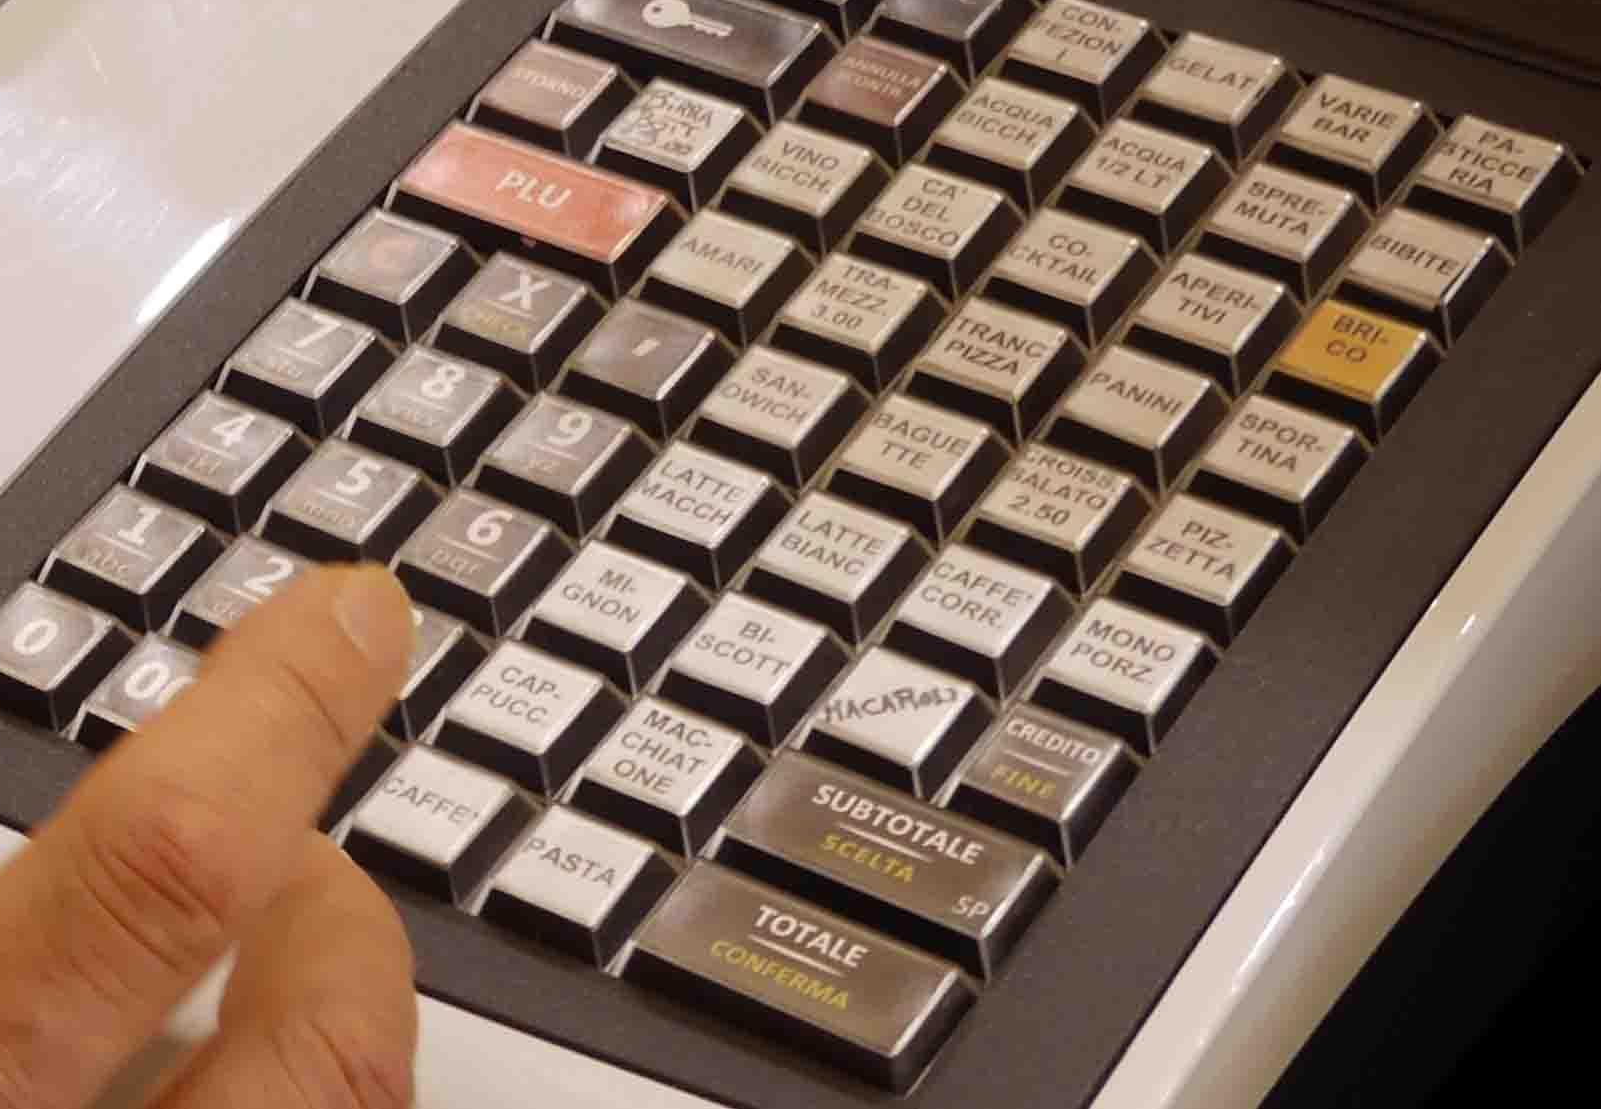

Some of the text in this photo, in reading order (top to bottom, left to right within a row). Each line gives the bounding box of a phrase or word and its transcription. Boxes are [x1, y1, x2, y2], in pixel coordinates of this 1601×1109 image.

[1035, 17, 1121, 57] FEZION
[1061, 5, 1121, 34] CON-
[973, 95, 1056, 128] ACQUA
[1316, 91, 1398, 128] VARIE
[1312, 117, 1374, 144] BAR
[1478, 129, 1525, 155] PA-
[779, 139, 840, 171] VINO
[1094, 157, 1172, 189] 1/2 LT
[1102, 136, 1189, 173] ACQUA
[1439, 140, 1538, 181] STICCE
[496, 169, 571, 209] PLU
[1248, 180, 1328, 216] SPRE-
[1448, 167, 1497, 193] RIA
[903, 196, 952, 222] DEL
[1232, 202, 1312, 238] MUTA
[871, 209, 958, 247] BOSCO
[1048, 234, 1094, 257] CO-
[679, 237, 766, 275] AMARI
[1008, 243, 1100, 285] CKTAIL
[1370, 234, 1459, 277] BIBITE
[500, 272, 551, 310] X
[839, 264, 900, 293] TRA-
[1171, 268, 1261, 310] APERI-
[809, 304, 863, 331] 3.00
[1178, 297, 1230, 326] TIVI
[1332, 314, 1389, 345] BRI-
[296, 314, 341, 348] 7
[944, 341, 1022, 377] PIZZA
[1326, 338, 1369, 365] CO
[420, 363, 464, 398] 8
[1089, 371, 1184, 416] PANINI
[721, 384, 811, 425] DWICH
[211, 412, 256, 448] 4
[547, 412, 593, 445] 9
[872, 412, 971, 459] BAGUE
[1238, 412, 1330, 453] SPOR-
[880, 441, 928, 469] TTE
[1236, 441, 1299, 473] TINA
[335, 458, 382, 494] 5
[659, 461, 741, 502] LATTE
[1008, 467, 1108, 510] SALATO
[637, 478, 734, 527] MACCH
[1009, 497, 1071, 527] 2.50
[117, 507, 162, 544] 1
[466, 508, 513, 547] 6
[797, 510, 886, 553] LATTE
[1183, 521, 1234, 548] PIZ-
[243, 556, 294, 596] 2
[1148, 538, 1239, 581] ZETTA
[598, 567, 636, 593] MI-
[932, 560, 1034, 608] CAFFE'
[561, 582, 643, 623] GNON
[920, 586, 1005, 629] CORR.
[12, 619, 58, 655] 0
[738, 619, 777, 644] BI-
[1084, 620, 1177, 662] MONO
[693, 632, 789, 676] SCOTT
[500, 663, 561, 699] CAP-
[643, 708, 714, 749] MAC-
[1007, 720, 1098, 764] CREDITO
[621, 731, 706, 776] CHIAT
[613, 758, 673, 795] ONE
[992, 765, 1056, 798] FINE
[380, 777, 479, 826] CAFFE'
[812, 784, 984, 865] SUBTOTALE
[526, 835, 616, 885] PASTA
[820, 834, 914, 883] SCELTA
[953, 895, 988, 918] SP
[753, 905, 869, 968] TOTALE
[709, 940, 850, 1009] CONFERMA
